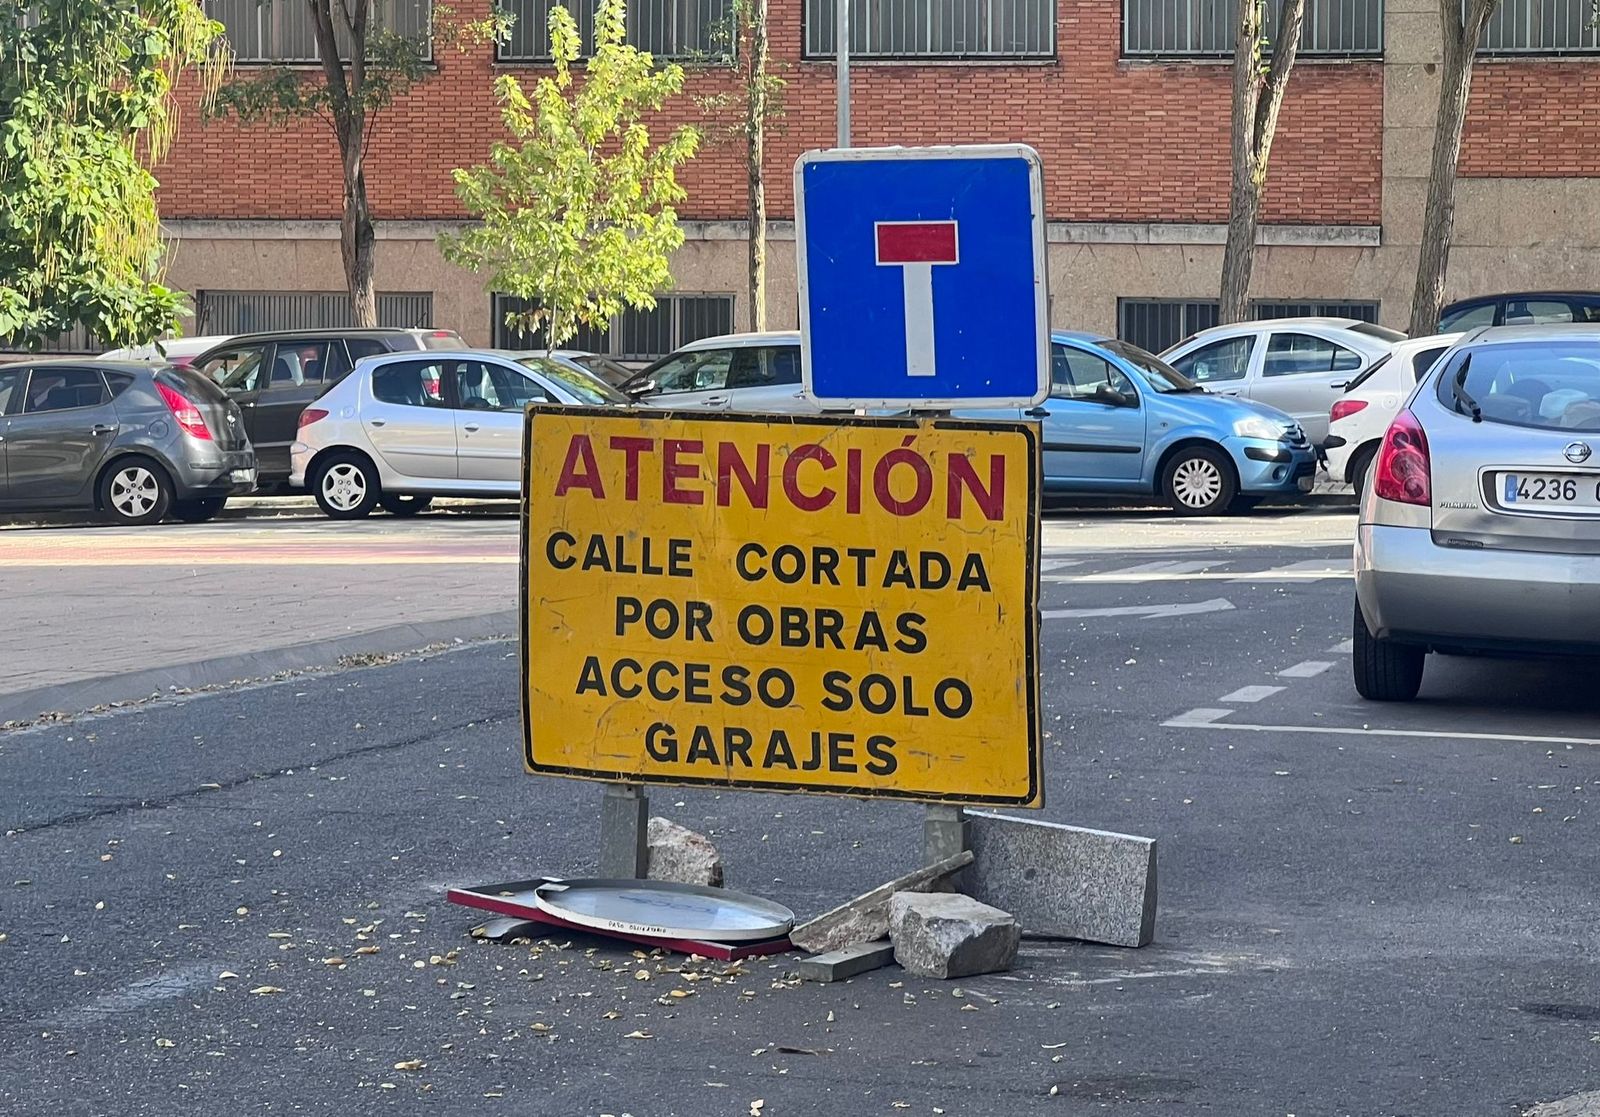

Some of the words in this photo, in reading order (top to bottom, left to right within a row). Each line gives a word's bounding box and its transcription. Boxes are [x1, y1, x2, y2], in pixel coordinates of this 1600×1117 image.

[554, 434, 1006, 521] ATENCIÓN
[1517, 477, 1577, 501] 4236
[546, 532, 692, 577] CALLE
[736, 543, 992, 592] CORTADA
[616, 597, 713, 642] POR
[738, 605, 928, 654] OBRAS
[576, 656, 795, 709] ACCESO
[821, 671, 973, 719] SOLO
[645, 723, 898, 776] GARAJES
